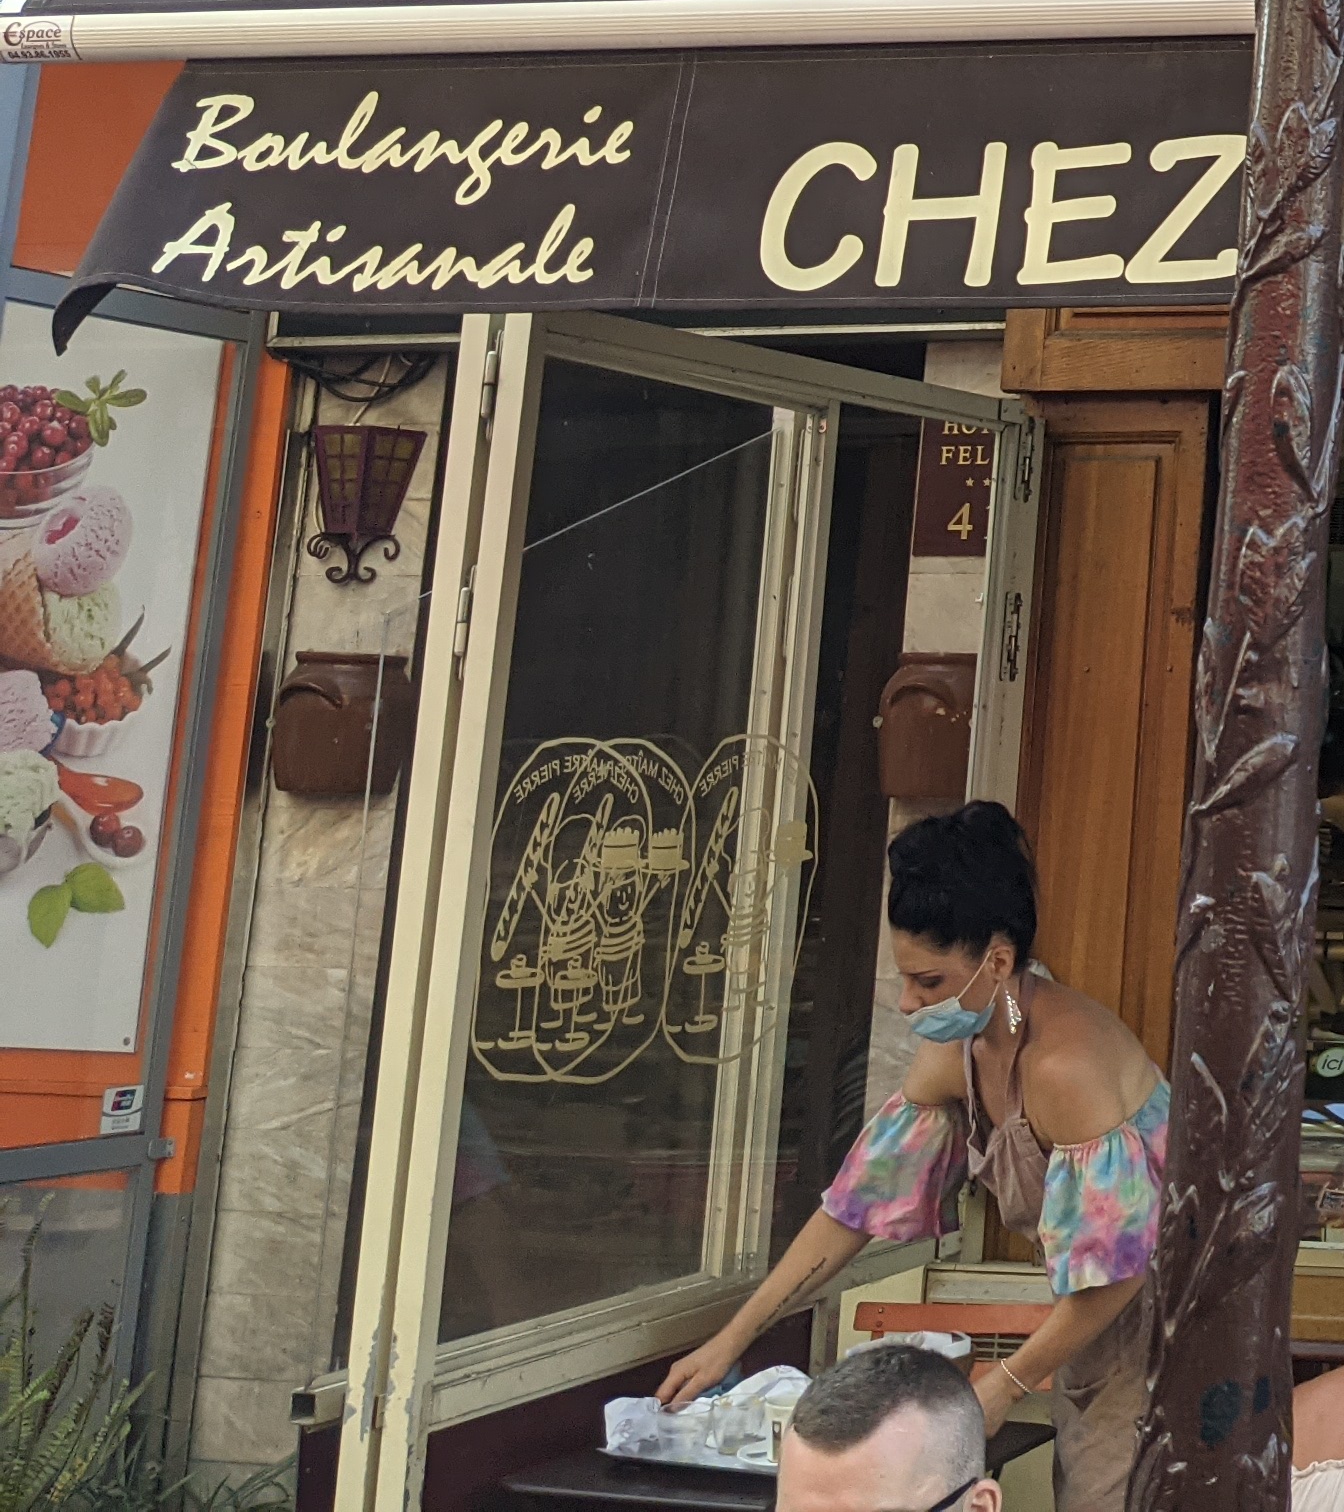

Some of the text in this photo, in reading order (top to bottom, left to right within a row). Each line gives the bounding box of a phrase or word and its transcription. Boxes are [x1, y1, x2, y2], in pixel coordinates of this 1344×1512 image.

[172, 90, 634, 205] Boulangerie
[151, 202, 595, 293] Artisanale
[760, 133, 1247, 292] CHEZ
[1321, 1054, 1344, 1070] ici
